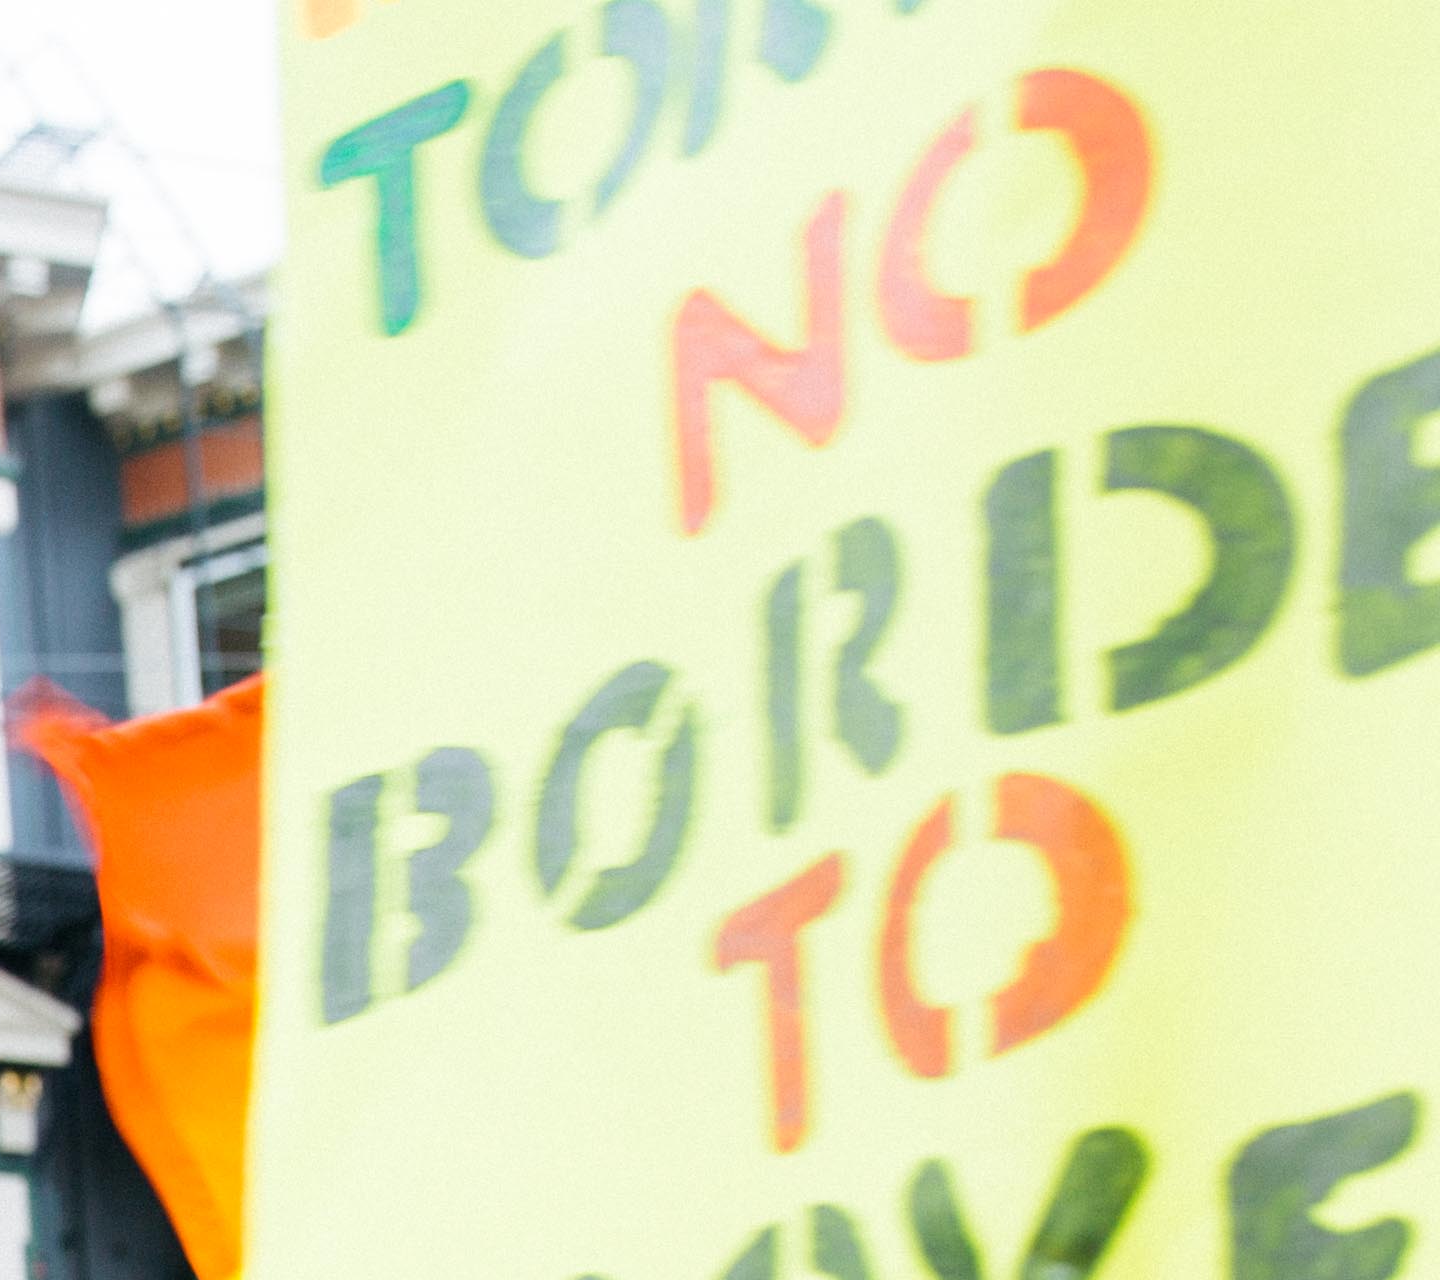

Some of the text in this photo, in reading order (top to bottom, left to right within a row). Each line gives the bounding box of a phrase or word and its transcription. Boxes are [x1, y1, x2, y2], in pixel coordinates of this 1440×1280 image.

[670, 68, 1158, 536] NO
[317, 345, 1440, 1025] BORDE
[714, 771, 1134, 1154] TO
